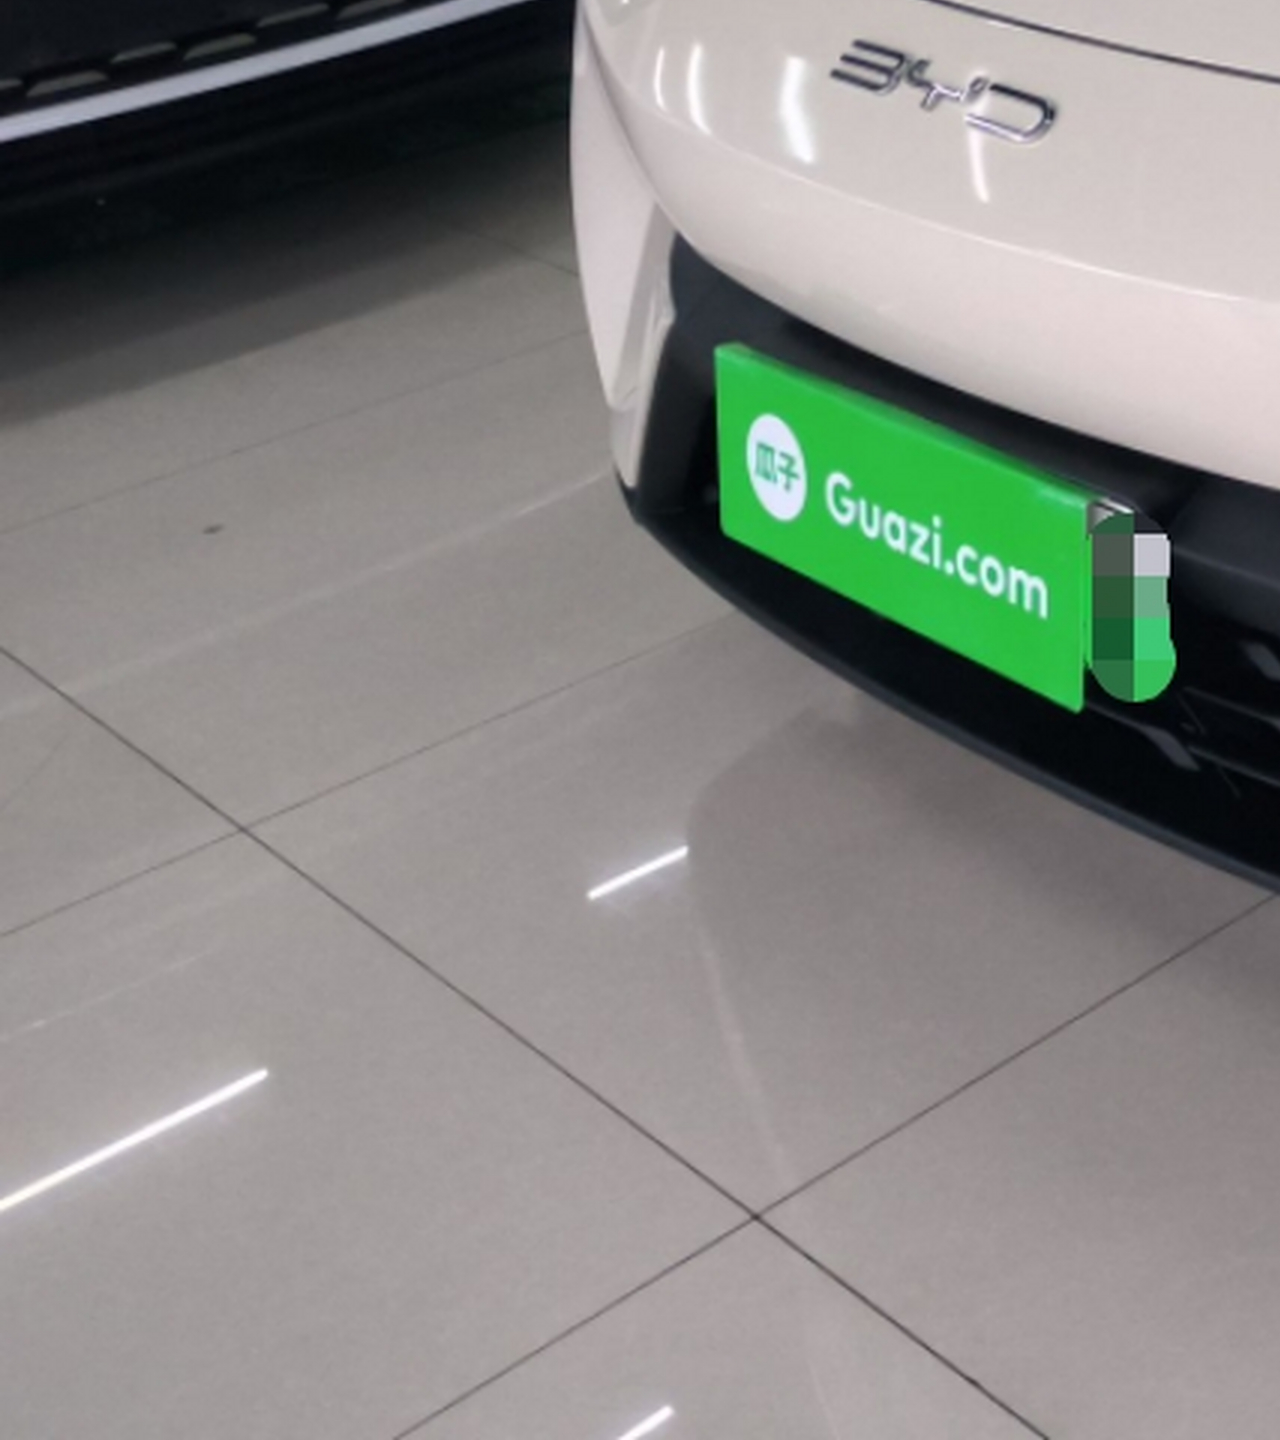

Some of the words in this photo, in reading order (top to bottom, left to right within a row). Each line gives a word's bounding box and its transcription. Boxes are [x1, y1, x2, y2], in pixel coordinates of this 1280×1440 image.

[830, 38, 1056, 143] BYD
[755, 440, 801, 494] 瓜子
[825, 471, 1048, 619] Guazi.com
